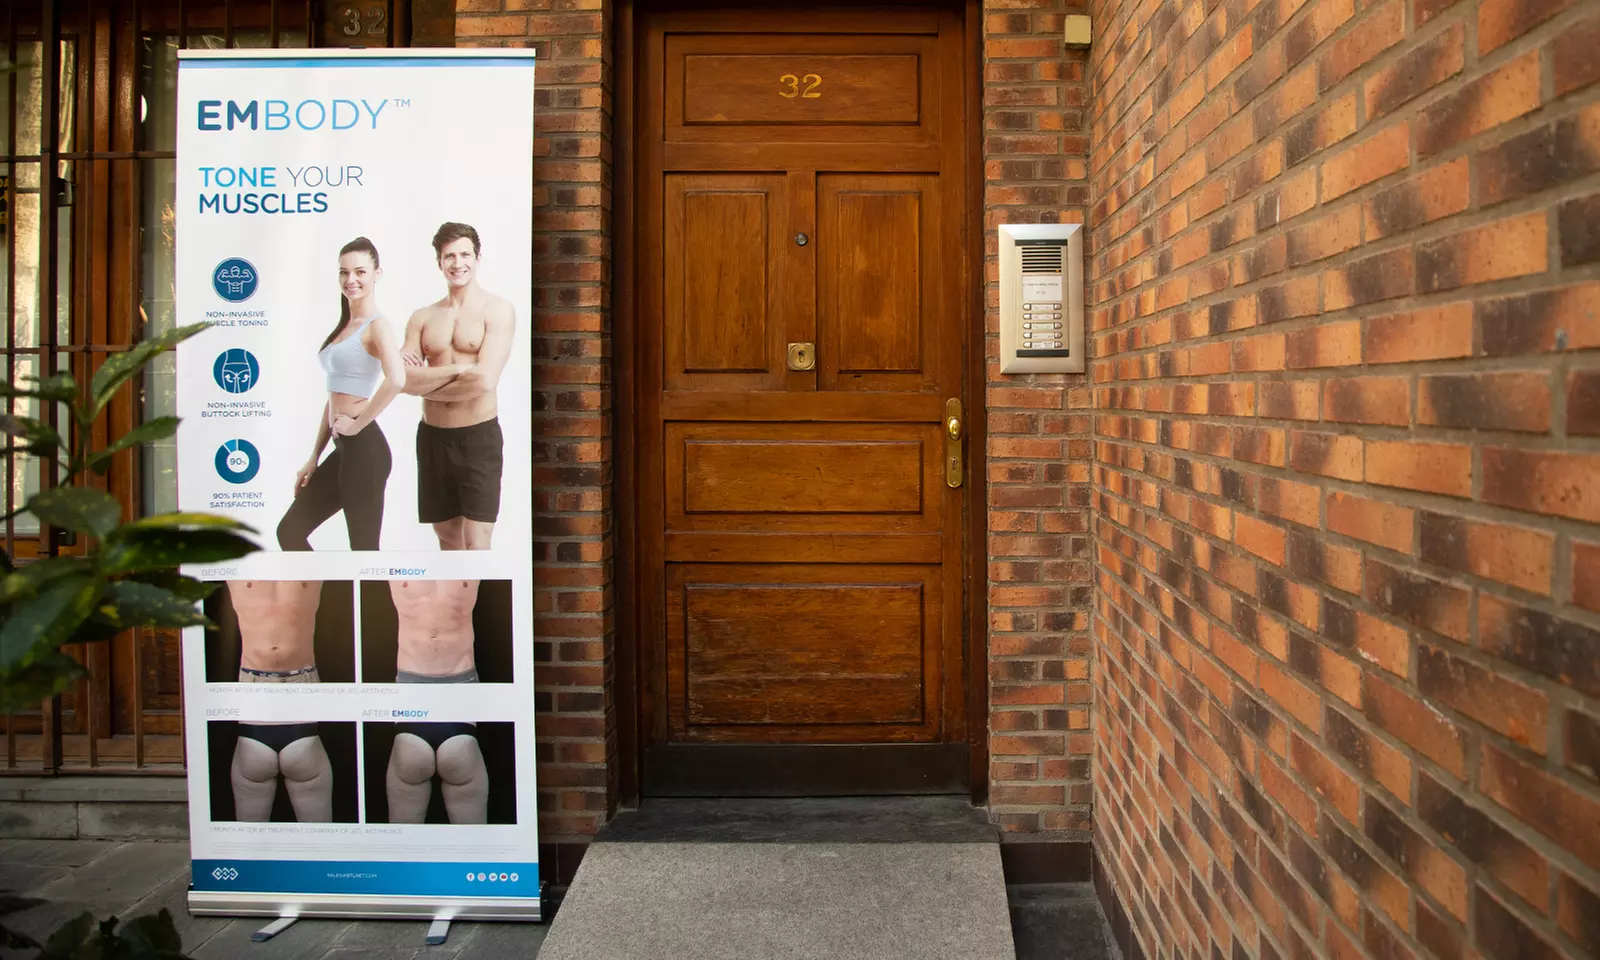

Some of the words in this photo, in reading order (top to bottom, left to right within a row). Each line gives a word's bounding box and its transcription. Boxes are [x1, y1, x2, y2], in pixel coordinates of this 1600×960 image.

[344, 8, 385, 36] 32
[779, 74, 822, 98] 32
[197, 99, 388, 131] EMBODY
[198, 167, 277, 188] TONE
[286, 166, 363, 187] YOUR
[199, 192, 328, 214] MUSCLES
[207, 401, 266, 409] NON-INVASIVE
[201, 410, 240, 418] BUTTOCK
[201, 567, 237, 577] BEFORE
[359, 568, 386, 576] AFTER
[389, 568, 427, 576] EMBODY
[206, 708, 240, 716] BEFORE
[361, 709, 389, 717] AFTER
[391, 709, 429, 717] EMBODY
